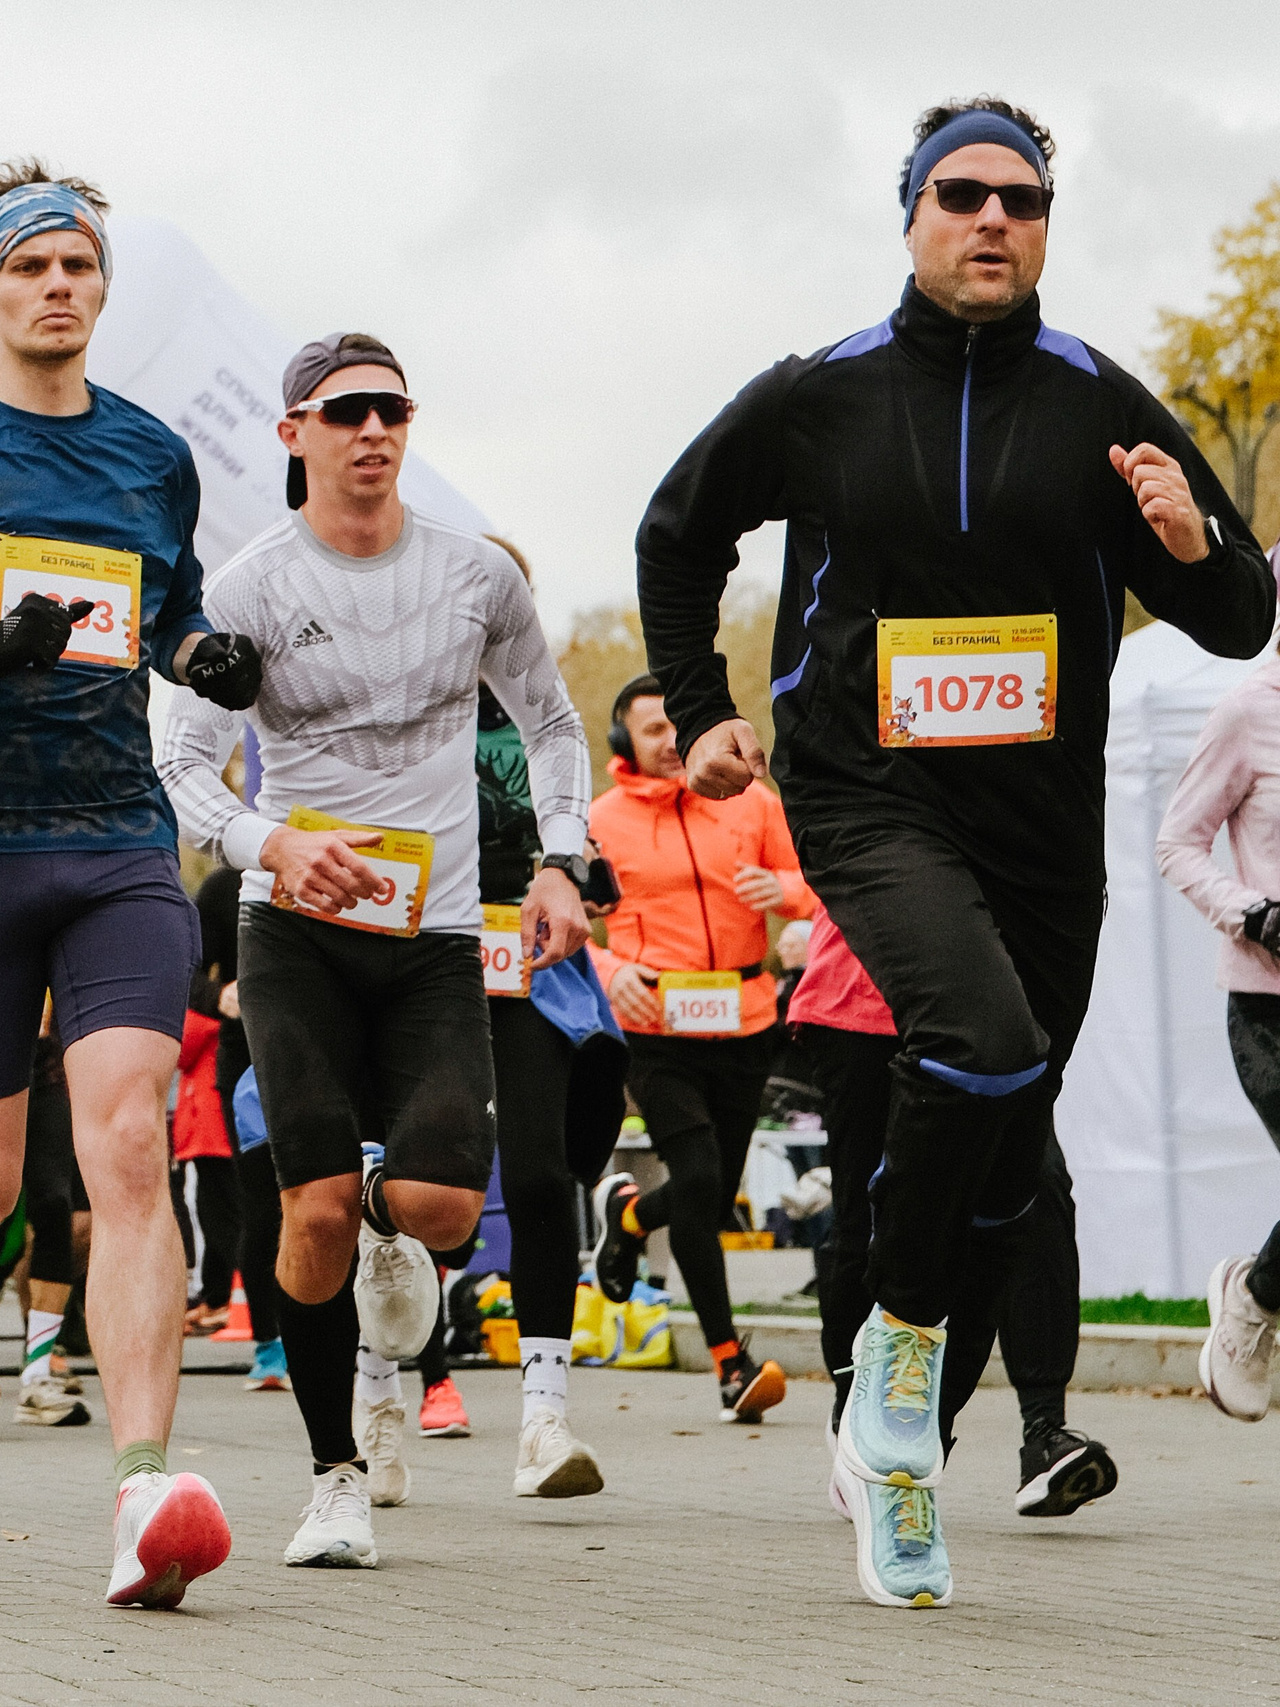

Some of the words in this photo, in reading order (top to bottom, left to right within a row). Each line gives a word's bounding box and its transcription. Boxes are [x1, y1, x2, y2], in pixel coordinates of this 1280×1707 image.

[41, 555, 57, 566] БЕЗ
[60, 558, 95, 572] ГРАНИЦ
[292, 634, 333, 648] adidas
[932, 635, 953, 646] БЕЗ
[956, 634, 1001, 646] ГРАНИЦ
[1011, 635, 1045, 643] Москва
[201, 649, 241, 678] MOAX
[914, 673, 1024, 713] 1078
[679, 999, 728, 1019] 1051
